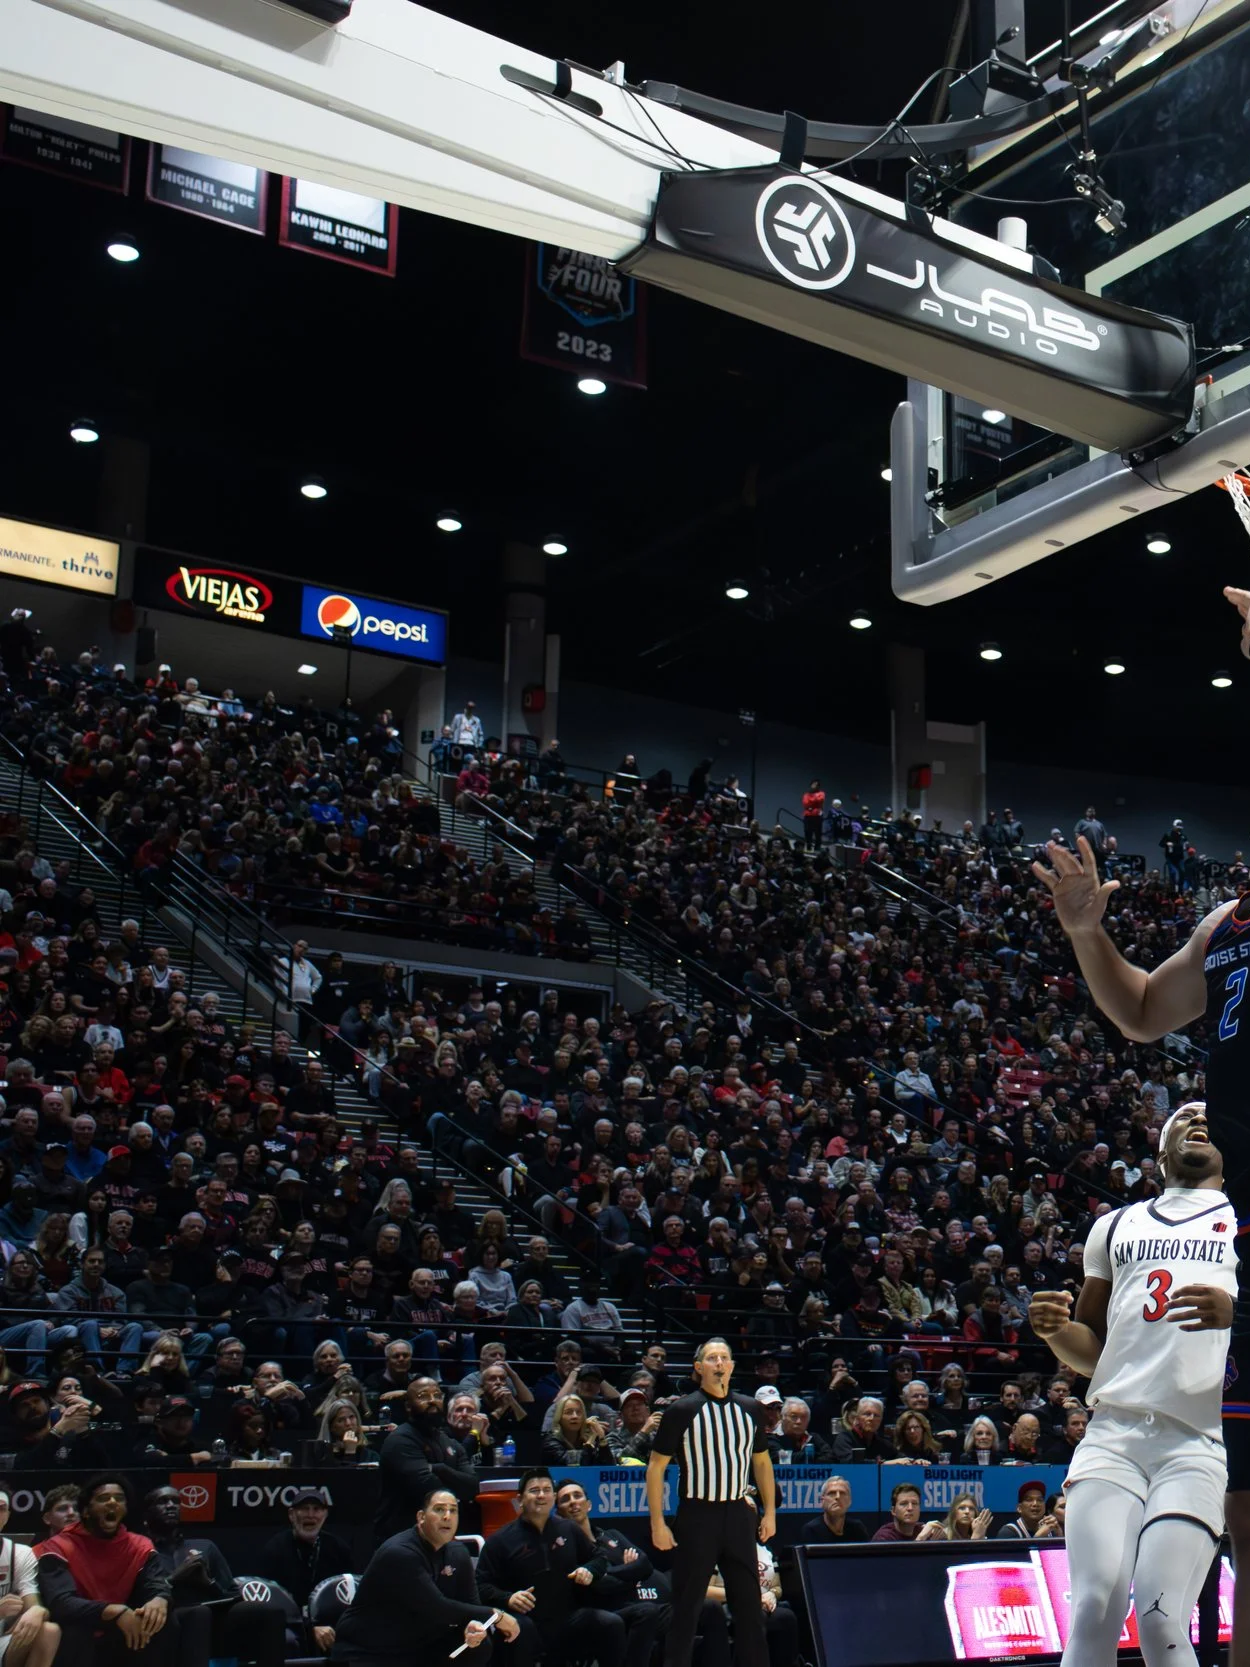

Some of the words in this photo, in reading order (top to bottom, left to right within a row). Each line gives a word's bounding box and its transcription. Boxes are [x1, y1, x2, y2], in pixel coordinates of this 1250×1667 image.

[160, 168, 216, 196] MICHAEL
[221, 187, 255, 209] CAGE
[290, 211, 332, 234] KAWHI
[335, 223, 388, 250] LEONARD
[561, 265, 622, 302] FOUR
[866, 259, 1101, 351] JLAB
[920, 299, 1058, 355] AUDIO
[556, 331, 613, 362] 2023
[62, 558, 114, 580] thrive
[179, 566, 259, 612] VIEJAS
[223, 606, 265, 623] arena
[363, 615, 429, 642] pepsi
[1204, 949, 1238, 973] BOISE
[1218, 966, 1249, 1042] 2
[1114, 1240, 1135, 1268] SAN
[1136, 1238, 1180, 1261] DIEGO
[1181, 1239, 1226, 1264] STATE
[1142, 1269, 1173, 1322] 3
[600, 1471, 629, 1482] BUD
[798, 1469, 833, 1480] LIGHT
[924, 1469, 950, 1479] BUD
[954, 1470, 984, 1479] LIGHT
[598, 1482, 671, 1513] SELTZR
